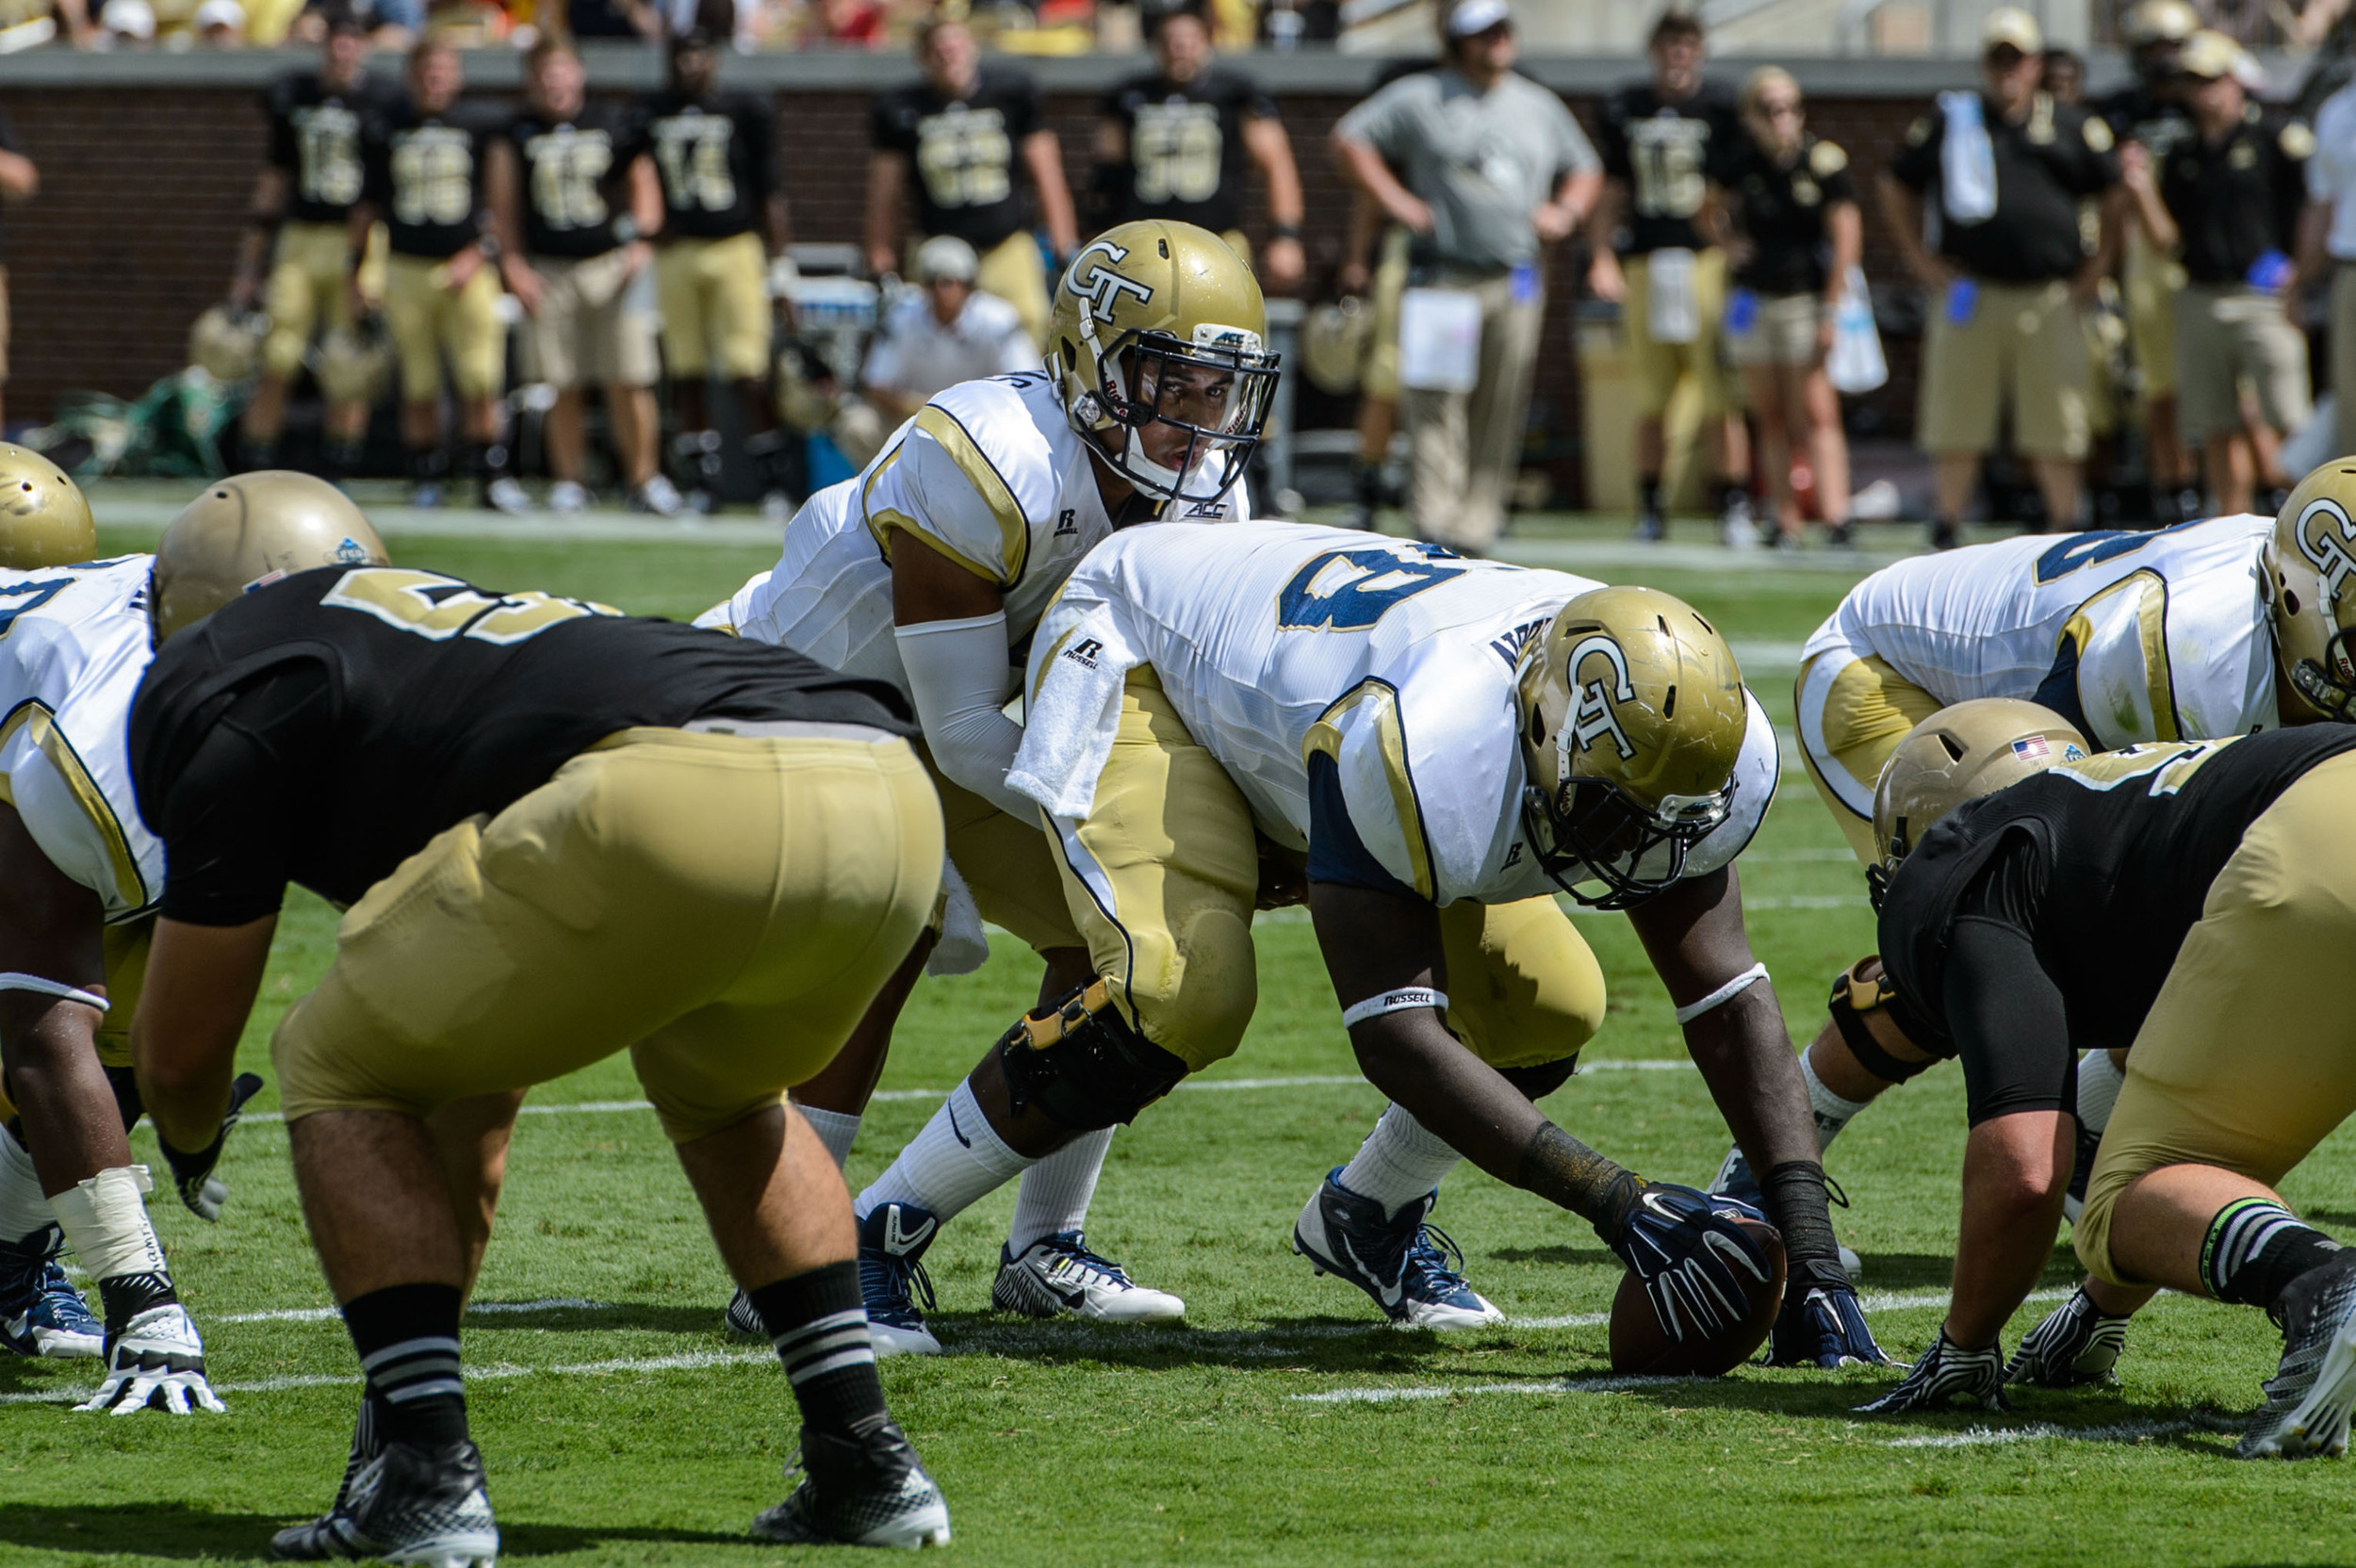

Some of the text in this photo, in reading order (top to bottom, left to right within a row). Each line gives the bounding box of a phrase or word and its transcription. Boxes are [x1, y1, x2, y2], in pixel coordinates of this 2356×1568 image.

[1185, 502, 1229, 519] ACC
[1063, 649, 1099, 670] RUSSELL
[1383, 993, 1431, 1006] RUSSELL
